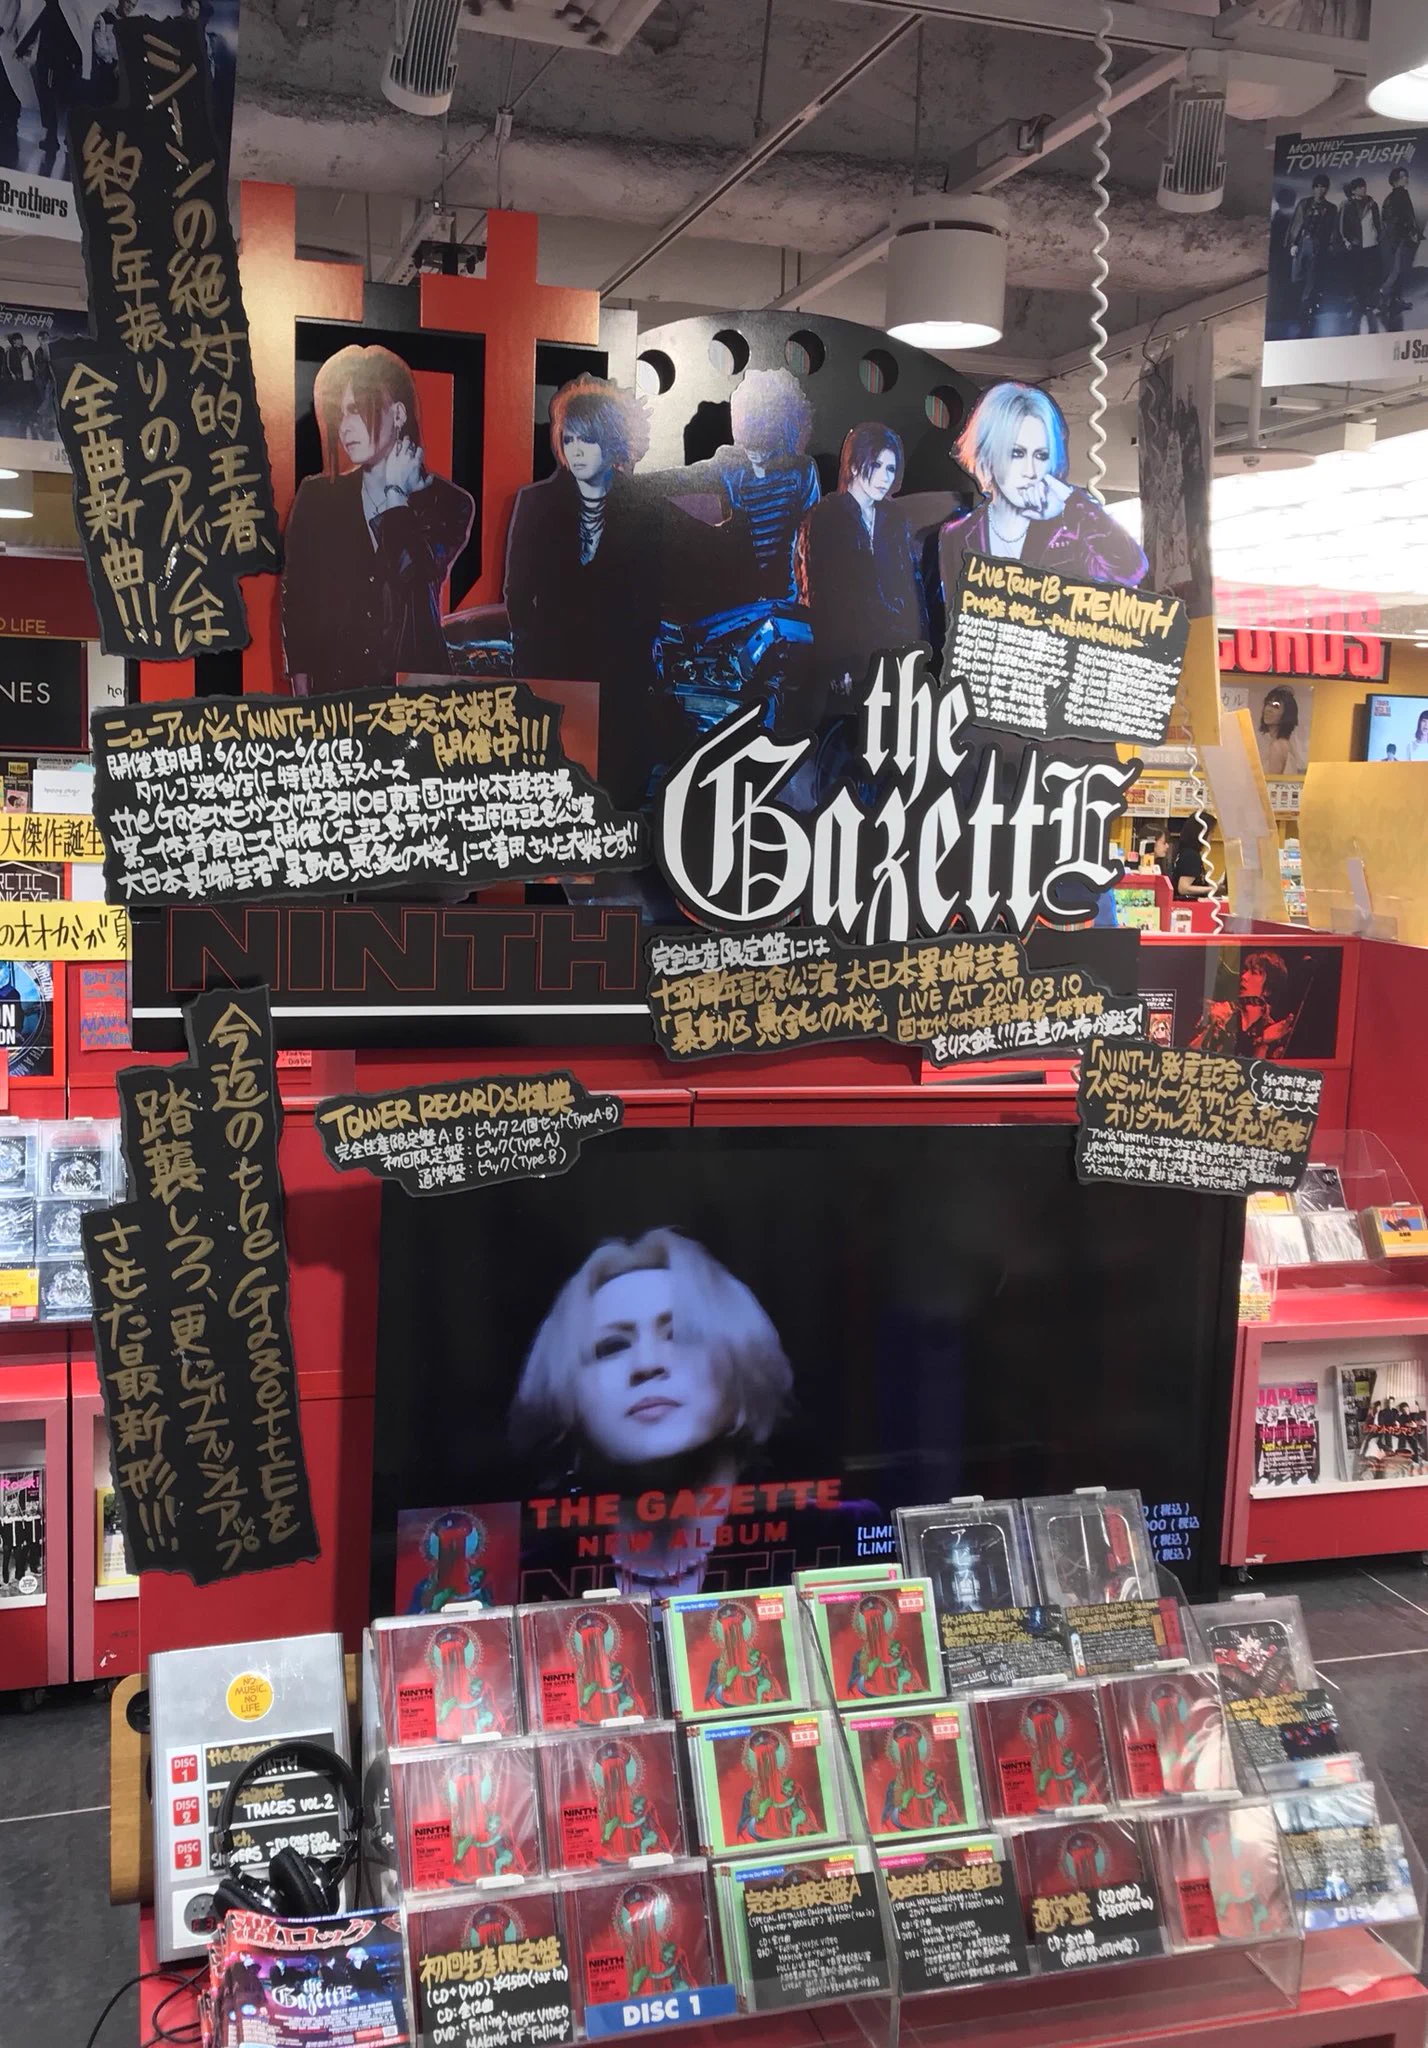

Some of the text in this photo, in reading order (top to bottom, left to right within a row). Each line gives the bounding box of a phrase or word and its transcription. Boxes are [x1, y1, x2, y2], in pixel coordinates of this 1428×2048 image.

[1289, 140, 1344, 154] MONTHLY
[1286, 151, 1353, 174] TOWER
[0, 179, 68, 218] Brothers
[11, 619, 50, 635] LIFE.
[862, 649, 969, 808] the
[166, 904, 639, 992] NINTH
[651, 932, 831, 976] 完全生産限定盤には
[651, 958, 839, 1012] 十五周年記念公演
[898, 986, 943, 1017] LIVE
[948, 983, 978, 1010] AT
[321, 1104, 418, 1144] TOWER
[530, 1478, 843, 1529] THE GAZETTE
[578, 1521, 789, 1557] NEW ALBUM
[243, 1678, 256, 1686] NO
[543, 1672, 576, 1683] NINTH
[245, 1695, 257, 1703] NO
[399, 1687, 433, 1698] NINTH
[174, 1758, 195, 1769] DISC
[1001, 1760, 1031, 1770] NINTH
[181, 1770, 189, 1781] 1
[175, 1800, 197, 1811] DISC
[243, 1798, 296, 1820] TRACES
[563, 1806, 598, 1818] NINTH
[182, 1811, 191, 1824] 2
[415, 1825, 450, 1837] NINTH
[177, 1843, 198, 1854] DISC
[184, 1853, 193, 1867] 3
[418, 1935, 562, 1991] 初回生産限定盤
[588, 1956, 625, 1968] NINTH
[537, 2003, 570, 2022] VIDEO
[623, 1994, 702, 2028] DISC 1
